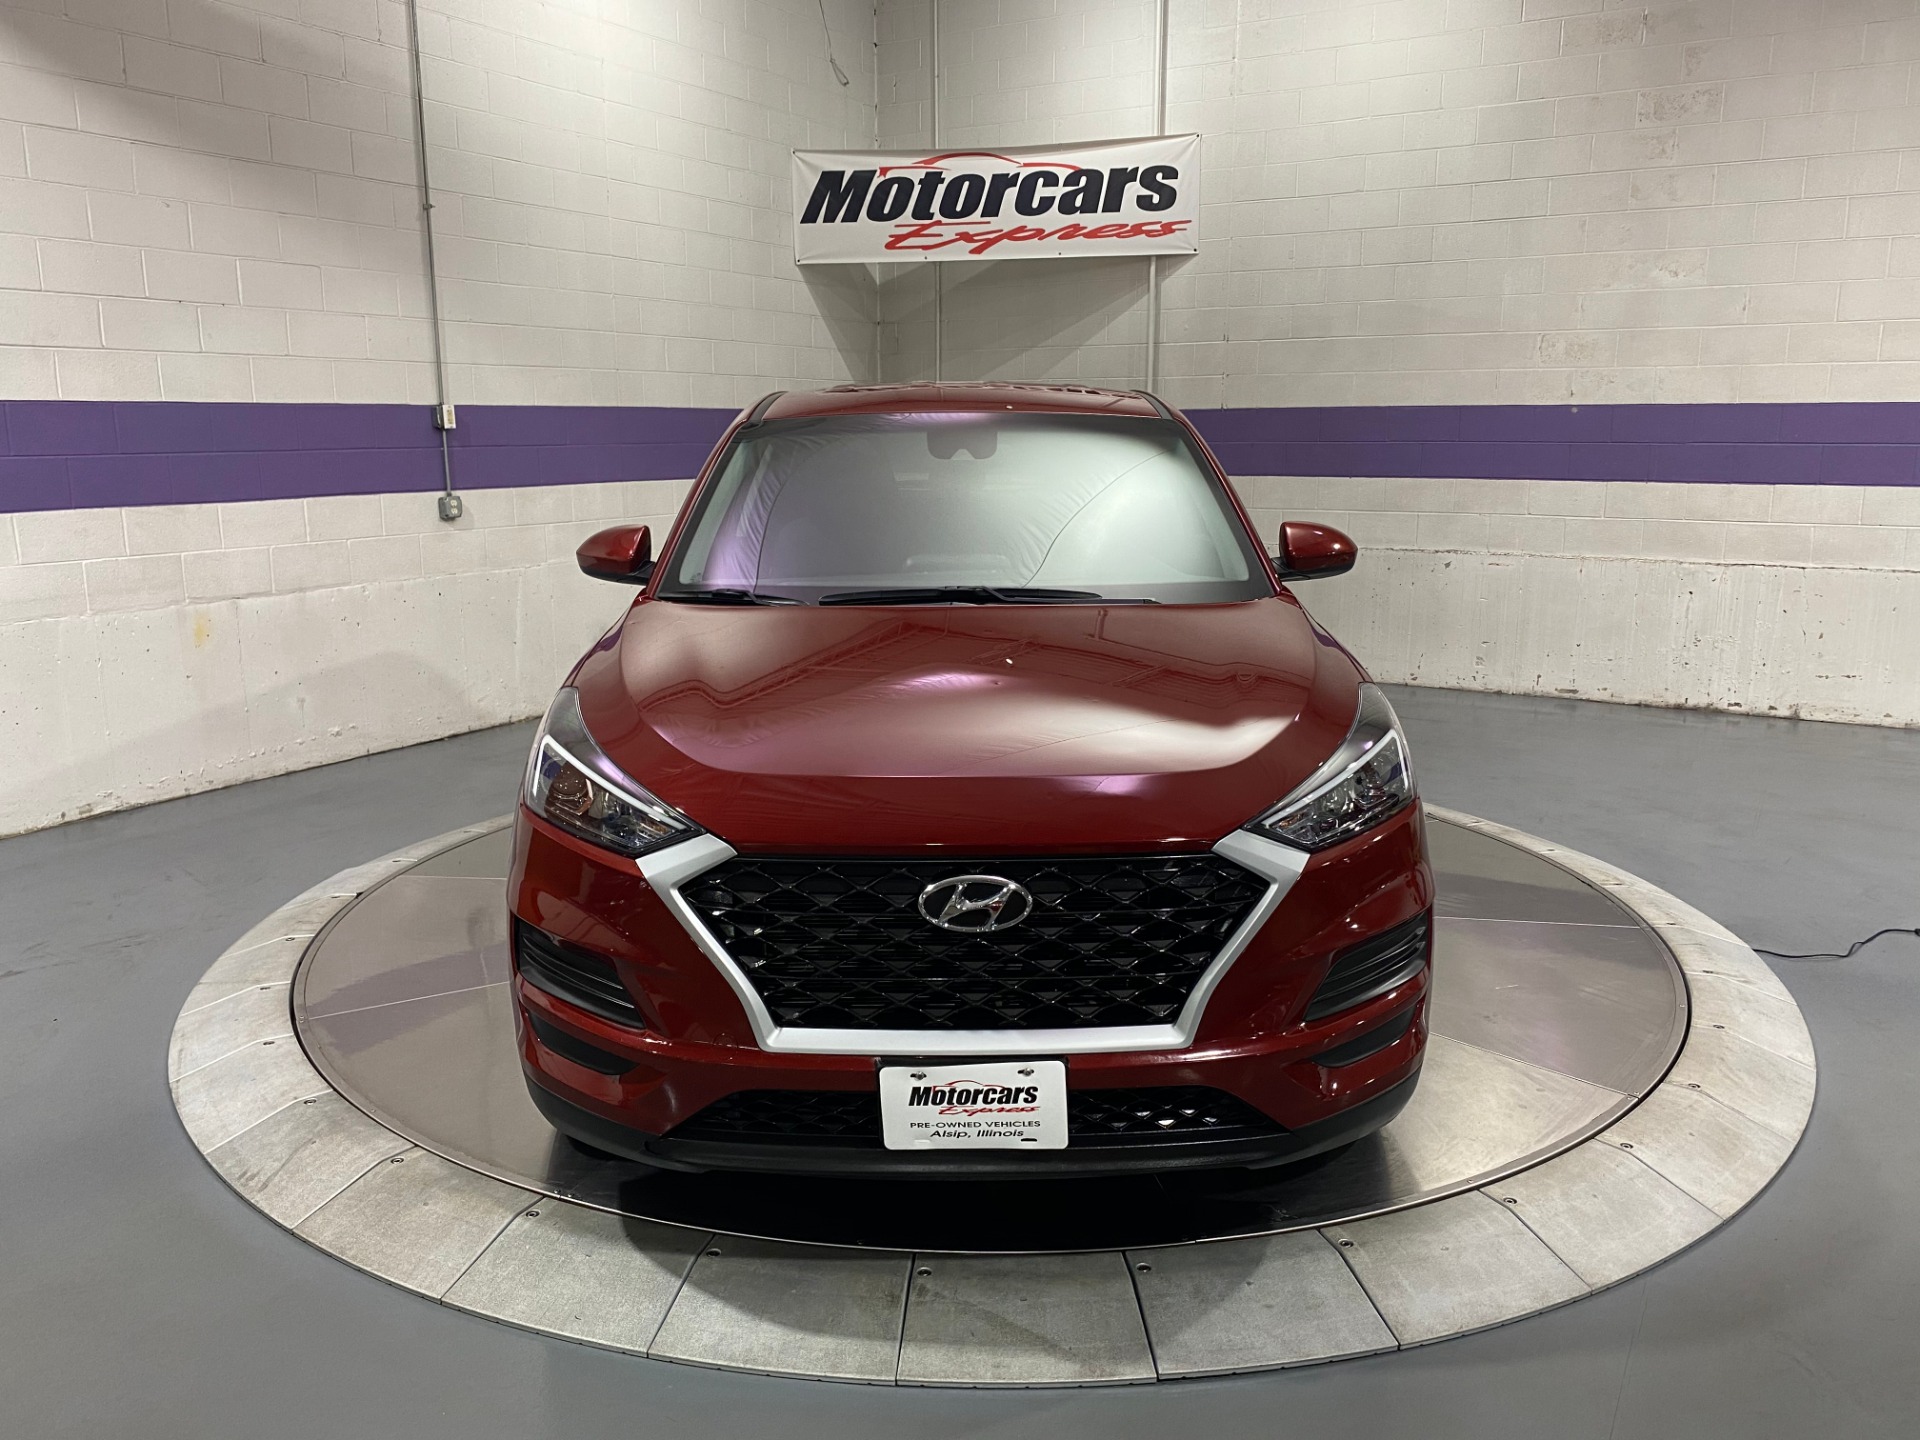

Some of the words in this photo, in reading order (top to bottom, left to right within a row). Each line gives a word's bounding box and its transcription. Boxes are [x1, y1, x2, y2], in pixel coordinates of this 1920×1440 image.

[799, 165, 1180, 224] Motorcars
[884, 218, 1193, 255] Express
[909, 1086, 1038, 1106] Motorcars
[939, 1105, 1040, 1117] Express
[985, 1120, 1041, 1128] VEHICLES
[930, 1130, 971, 1139] Alsip,
[976, 1129, 1024, 1137] Illinois
